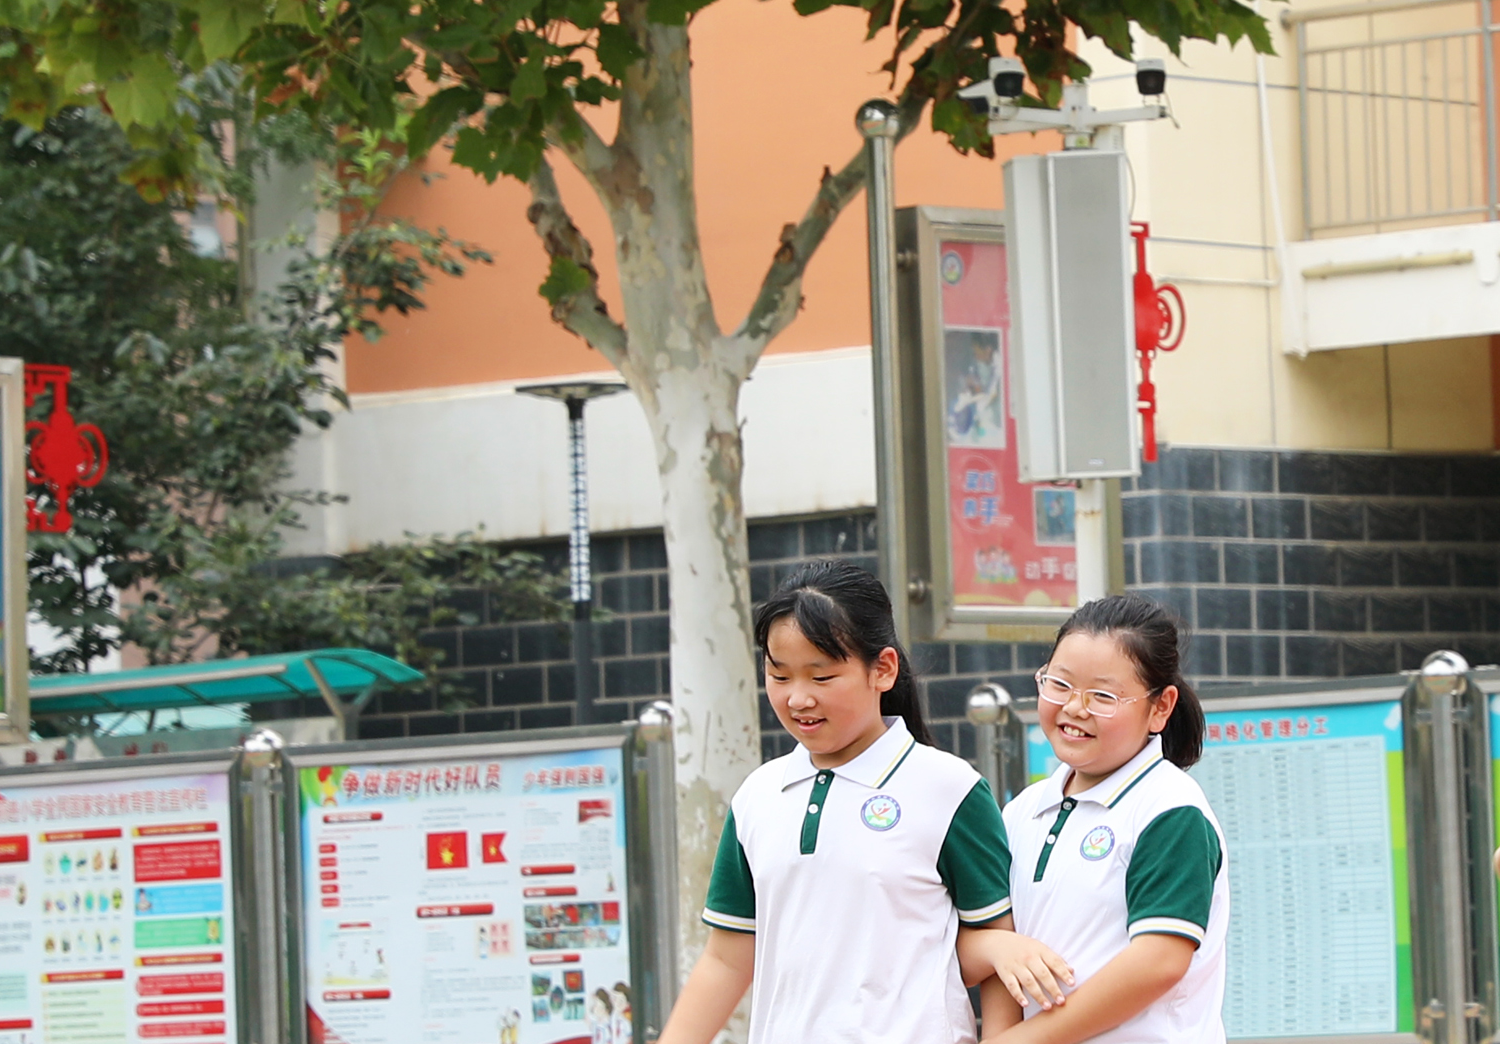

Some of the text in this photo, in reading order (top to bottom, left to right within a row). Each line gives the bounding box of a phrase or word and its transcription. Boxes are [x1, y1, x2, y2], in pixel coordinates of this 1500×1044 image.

[342, 764, 502, 799] 争做新时代好队员
